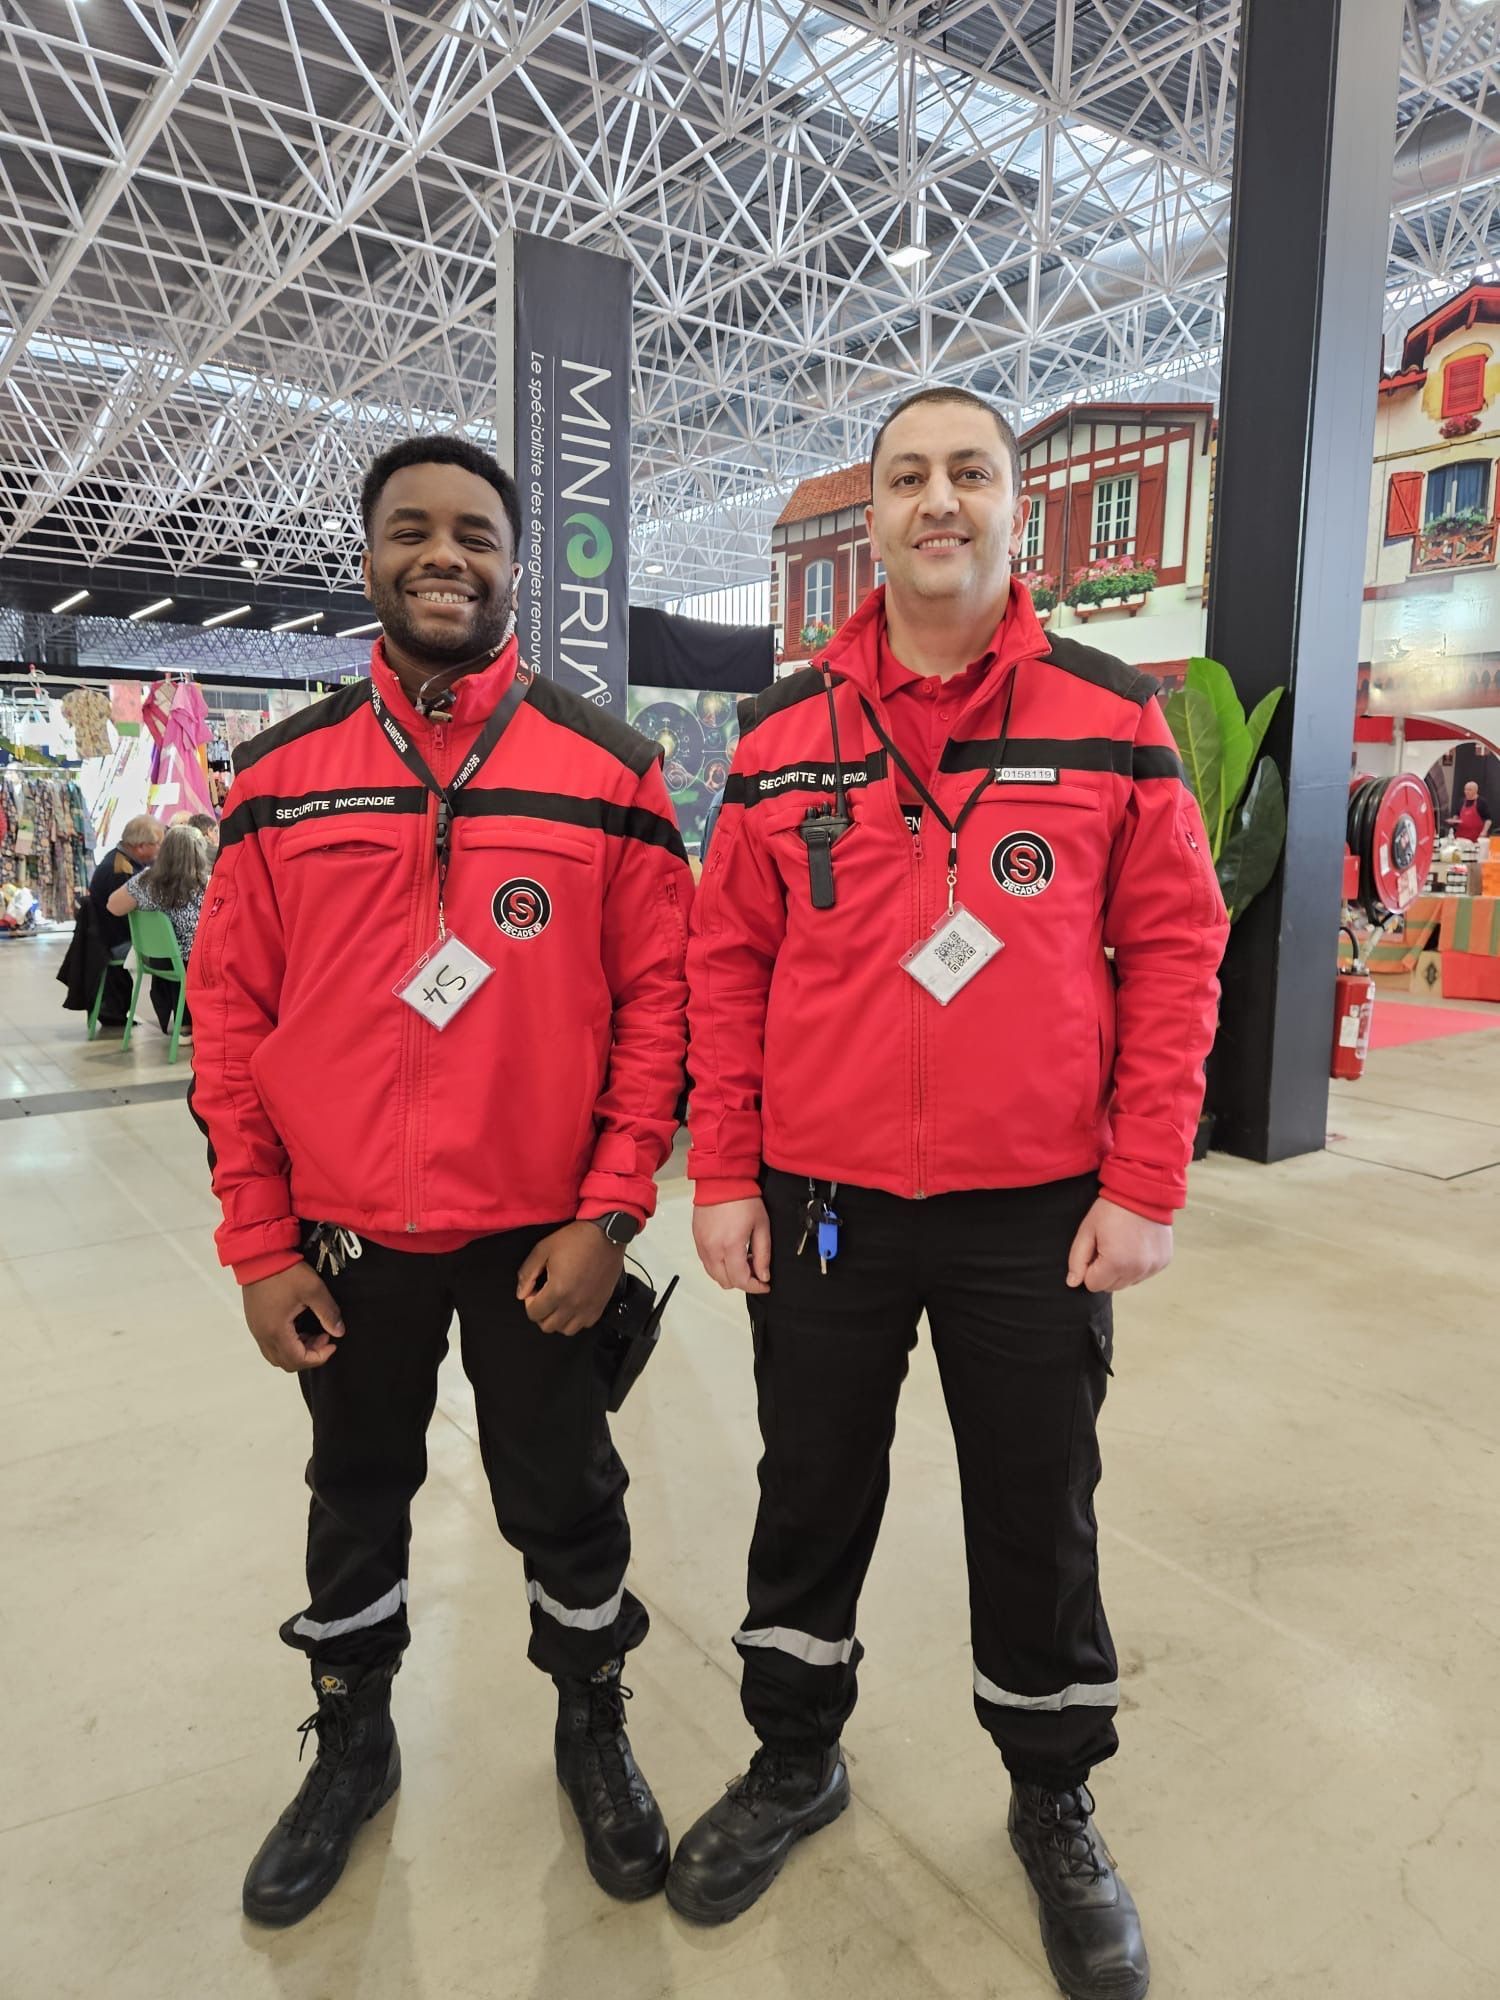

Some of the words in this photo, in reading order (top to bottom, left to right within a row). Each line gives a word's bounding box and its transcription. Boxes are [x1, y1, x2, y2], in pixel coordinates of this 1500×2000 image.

[530, 351, 545, 374] Le
[528, 377, 546, 477] spécialiste
[530, 481, 545, 515] des
[527, 519, 546, 597] énergies
[530, 600, 542, 674] renouve
[383, 717, 409, 753] SECURITE
[452, 754, 481, 791] SECURITE
[759, 771, 817, 790] SECURITE
[275, 800, 331, 820] SECURITE
[334, 796, 396, 809] INCENDIE
